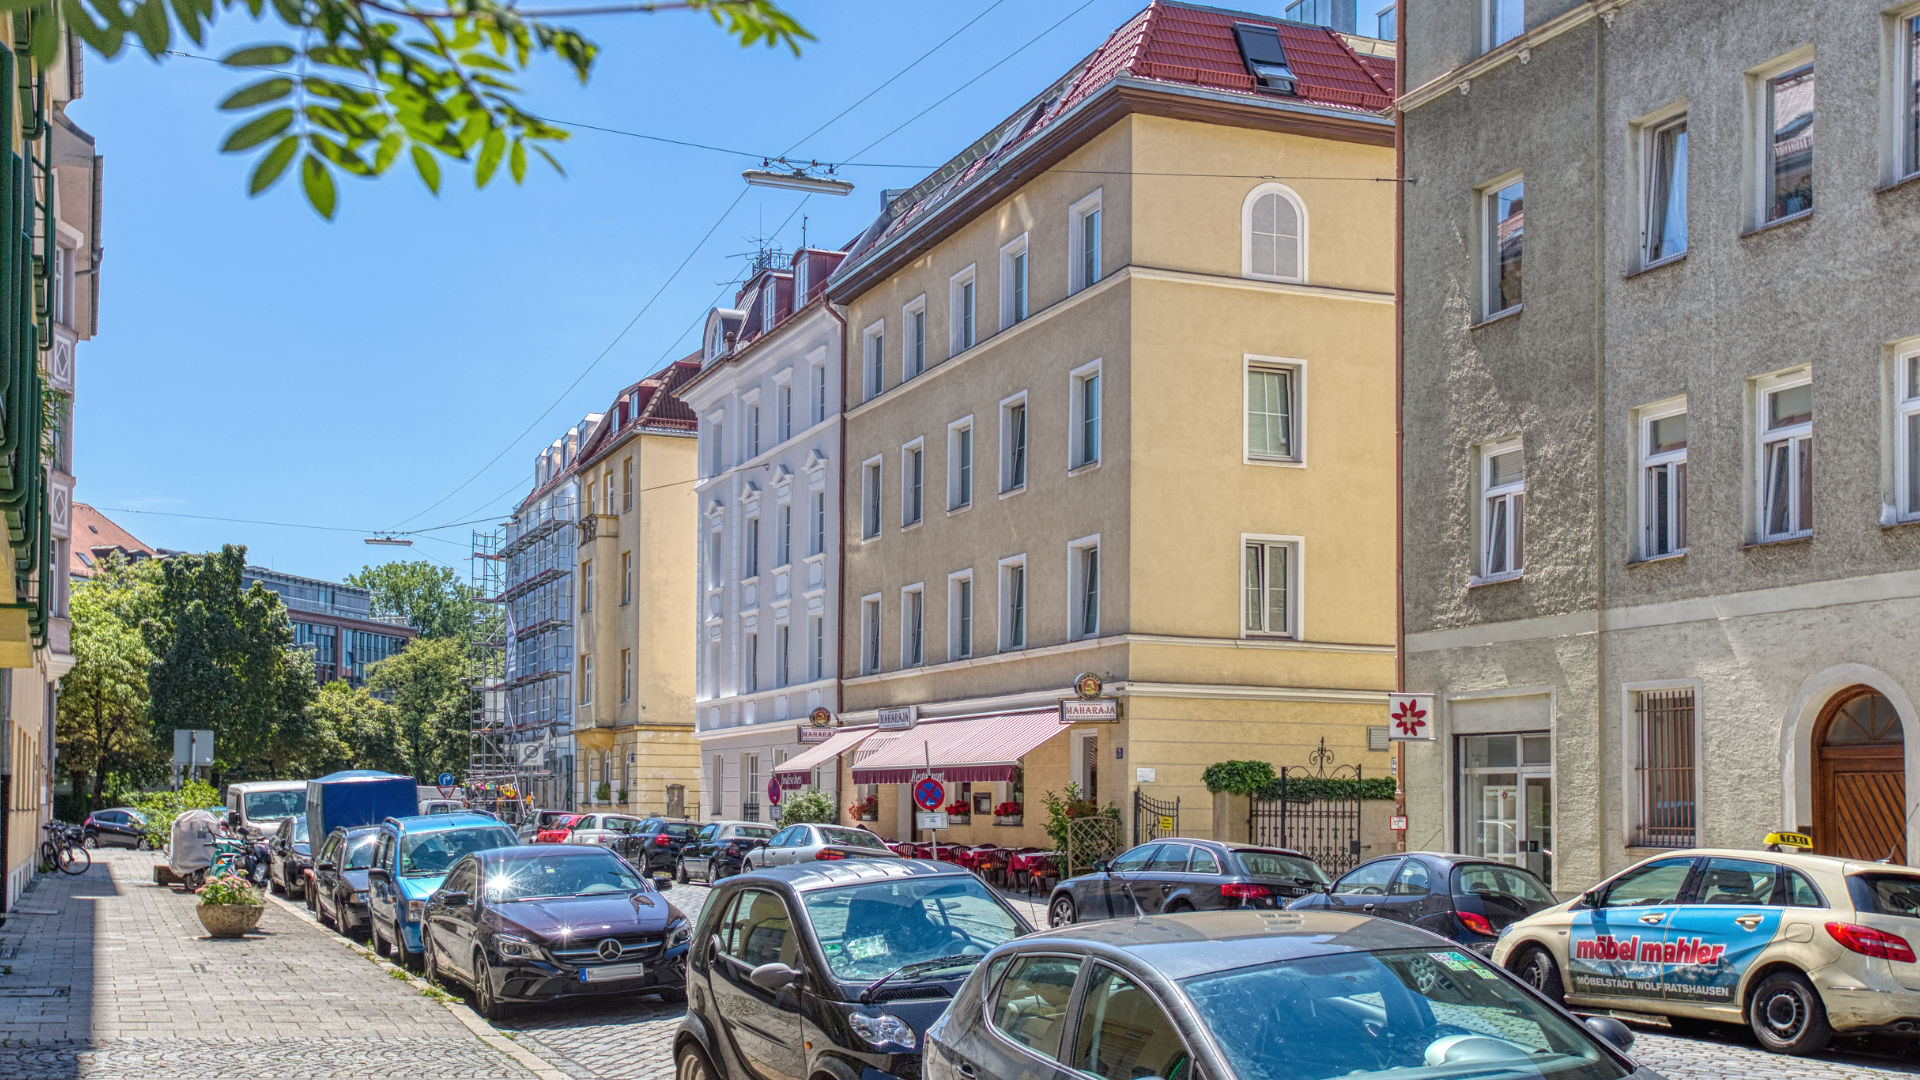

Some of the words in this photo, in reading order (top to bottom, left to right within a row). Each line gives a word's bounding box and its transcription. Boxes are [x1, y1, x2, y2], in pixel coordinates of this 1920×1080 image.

[1066, 706, 1116, 715] MAHARAJA
[1782, 835, 1807, 846] TAXI
[1575, 934, 1640, 962] möbel
[1640, 936, 1726, 966] mahler
[1576, 974, 1634, 989] MÖBELSTADT
